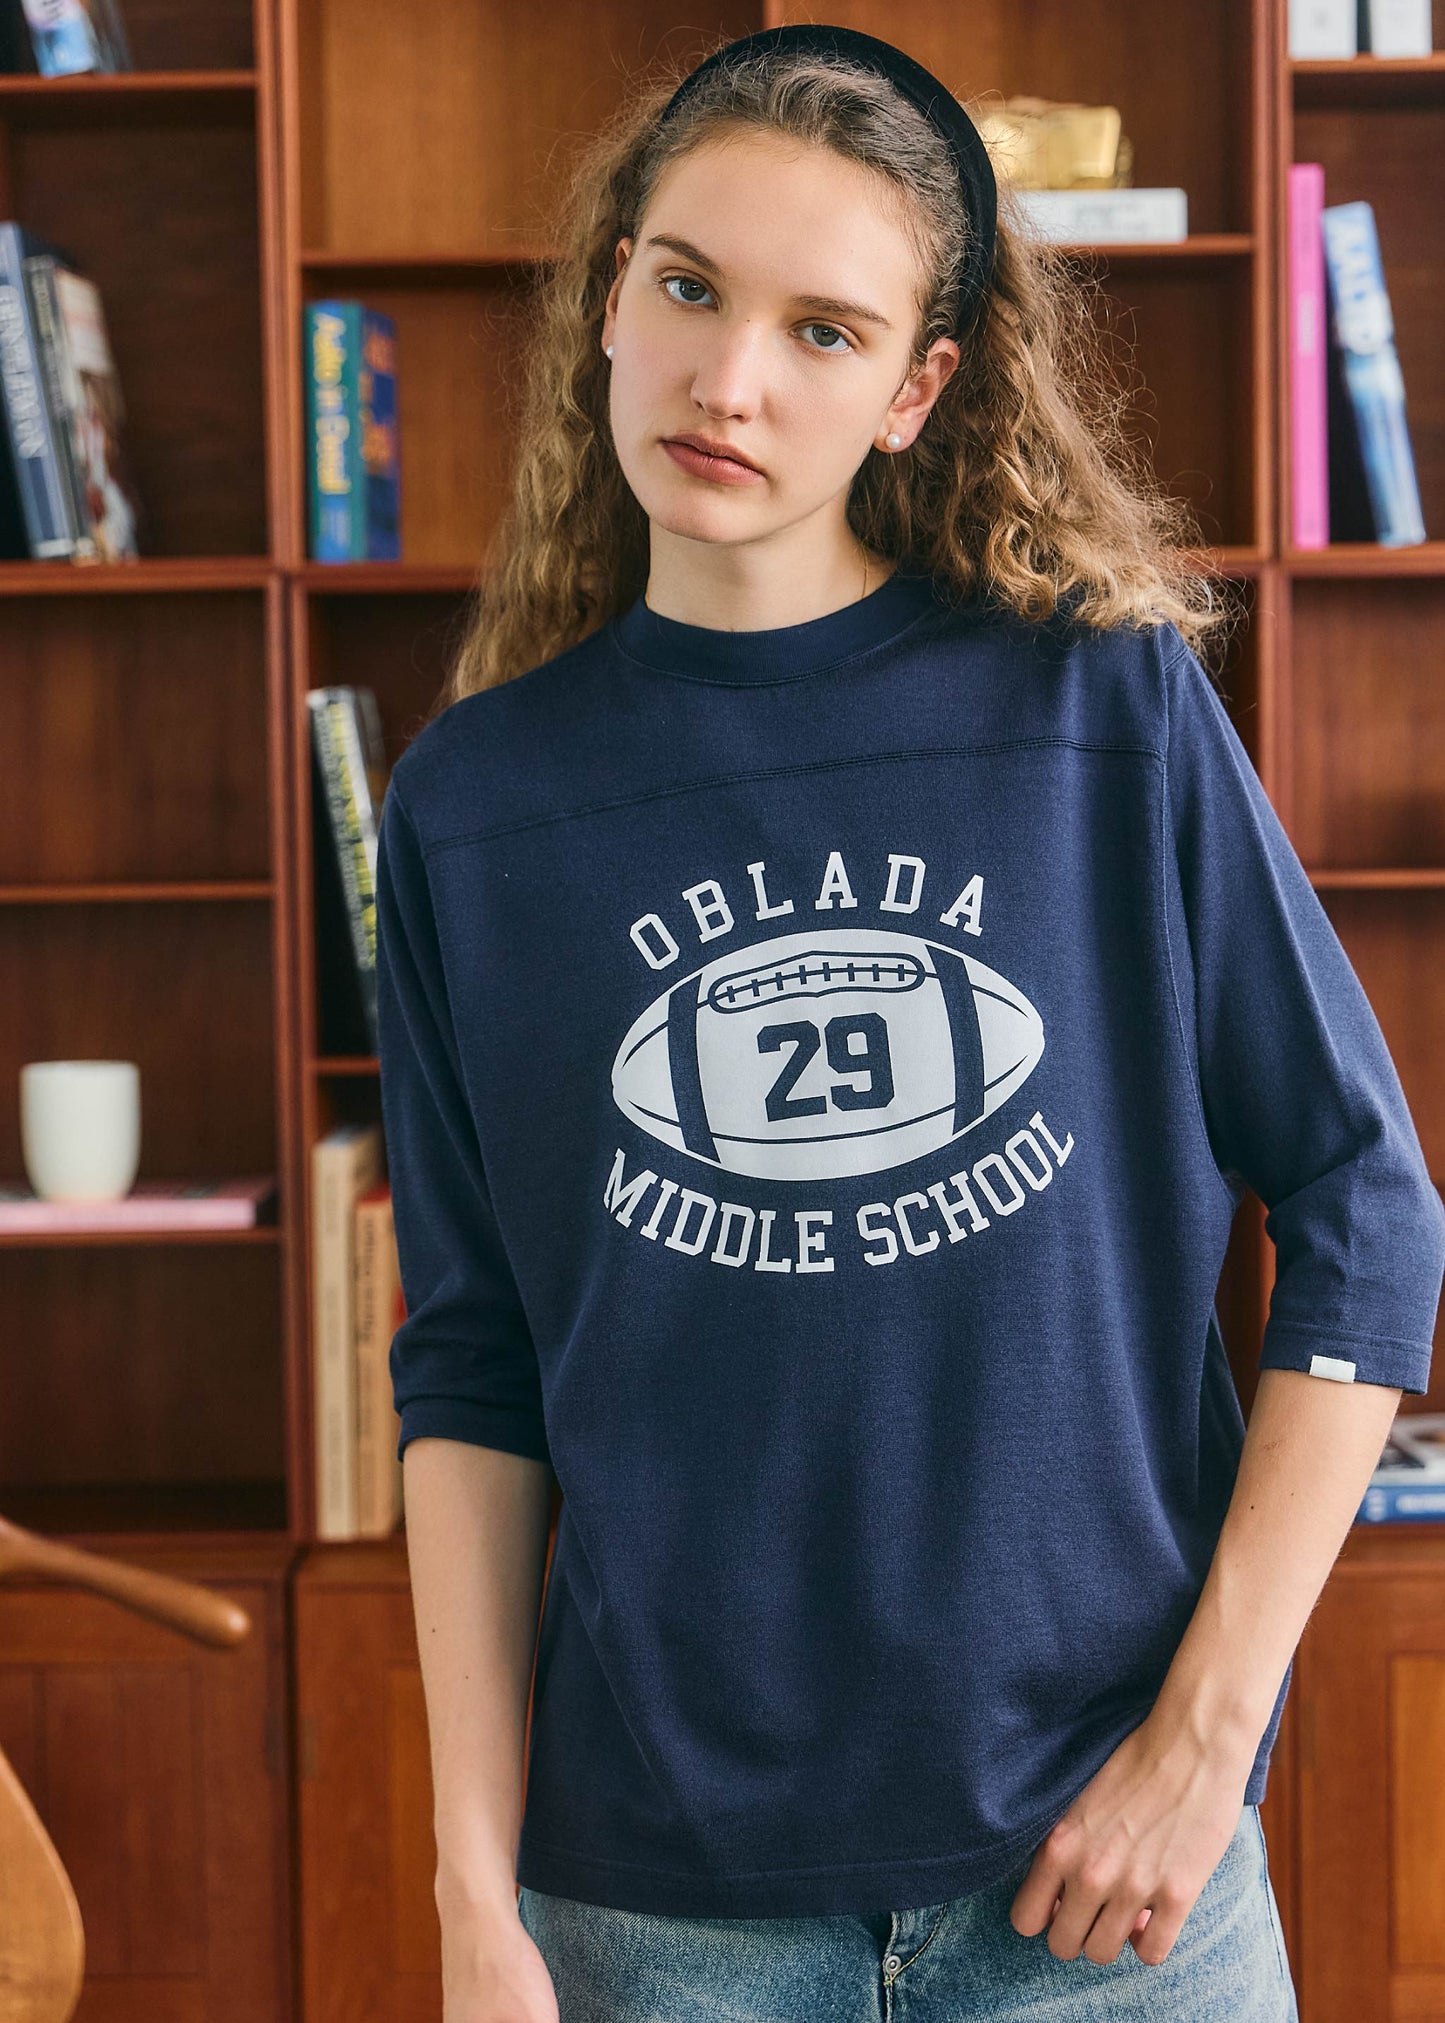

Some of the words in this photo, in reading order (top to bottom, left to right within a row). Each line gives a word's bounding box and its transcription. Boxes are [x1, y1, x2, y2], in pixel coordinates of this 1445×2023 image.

[629, 851, 985, 970] OBLADA
[756, 1012, 895, 1123] 29
[603, 1148, 835, 1273] MIDDLE
[856, 1110, 1075, 1267] SCHOOL
